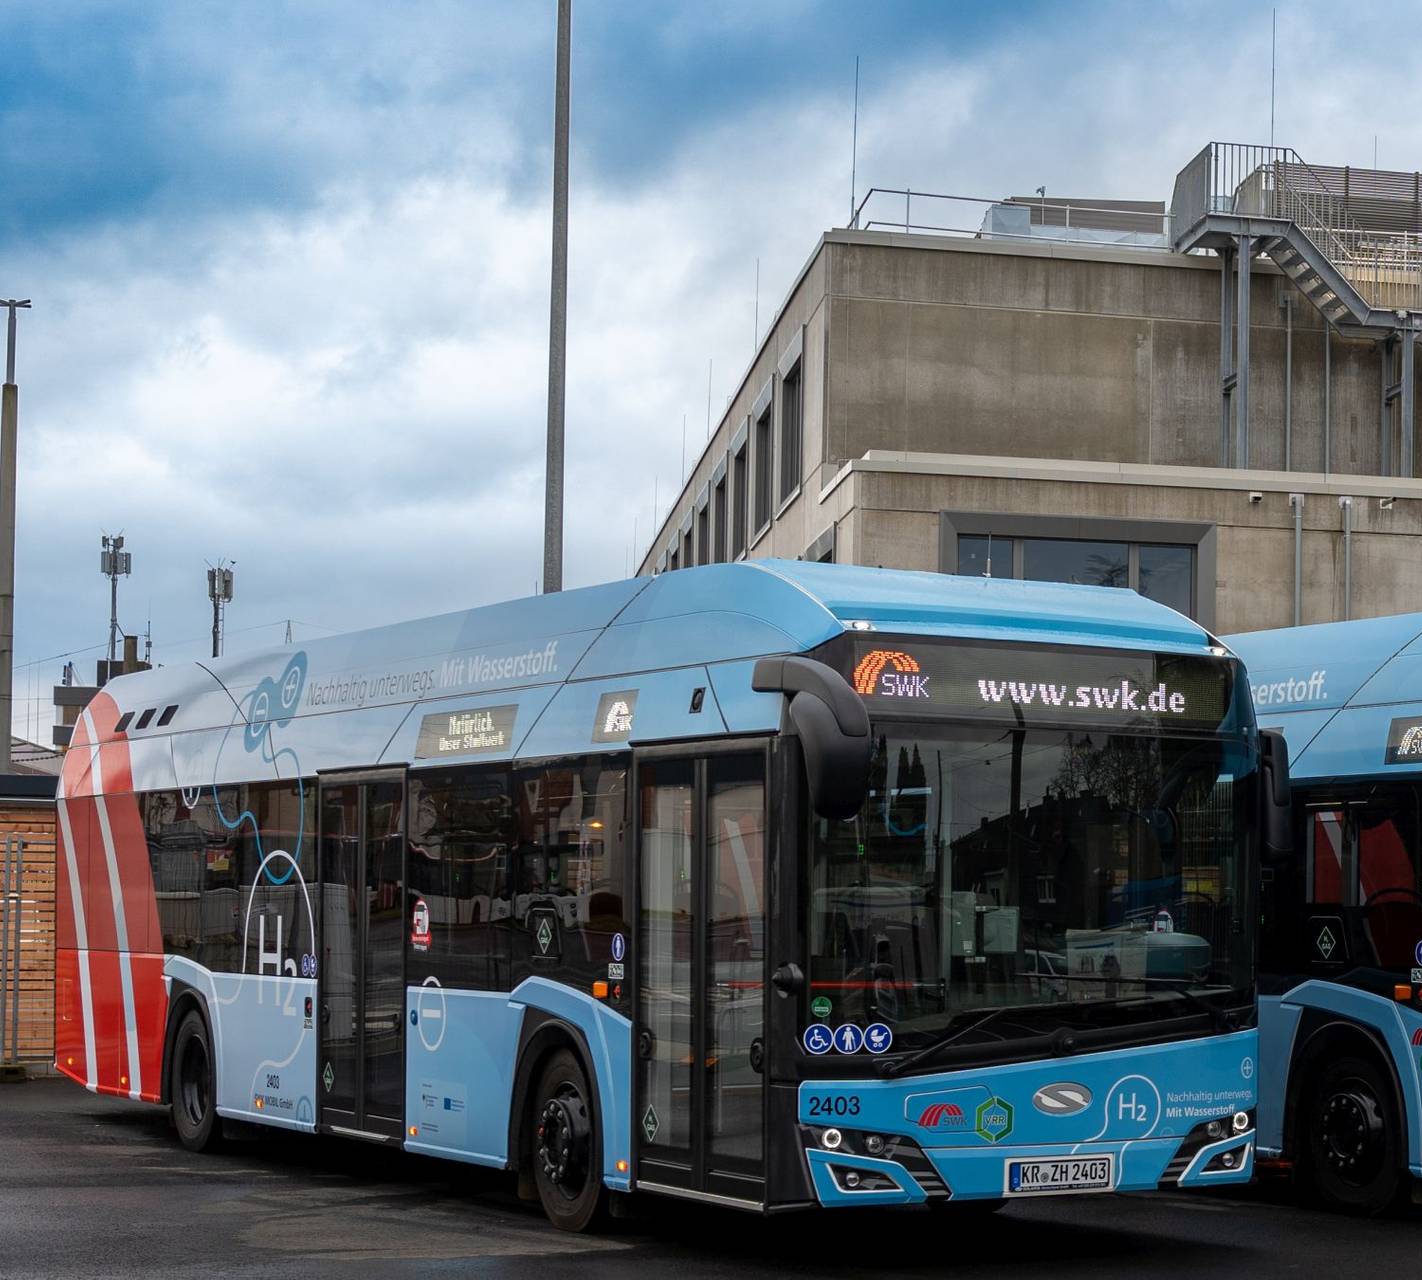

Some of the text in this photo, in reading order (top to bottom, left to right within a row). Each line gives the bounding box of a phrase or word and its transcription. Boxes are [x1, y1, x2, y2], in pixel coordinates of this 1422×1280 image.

[306, 675, 368, 706] Nachhaltig
[440, 658, 464, 688] Mit
[467, 640, 559, 683] Wasserstoff.
[881, 674, 930, 698] SWK
[978, 680, 1185, 713] www.swk.de
[809, 1096, 860, 1116] 2403
[1166, 1090, 1213, 1104] Nachhaltig
[943, 1116, 968, 1126] SWK
[984, 1114, 1008, 1126] VRR
[1166, 1107, 1182, 1118] Mit
[1022, 1162, 1107, 1184] KR ZH 2403
